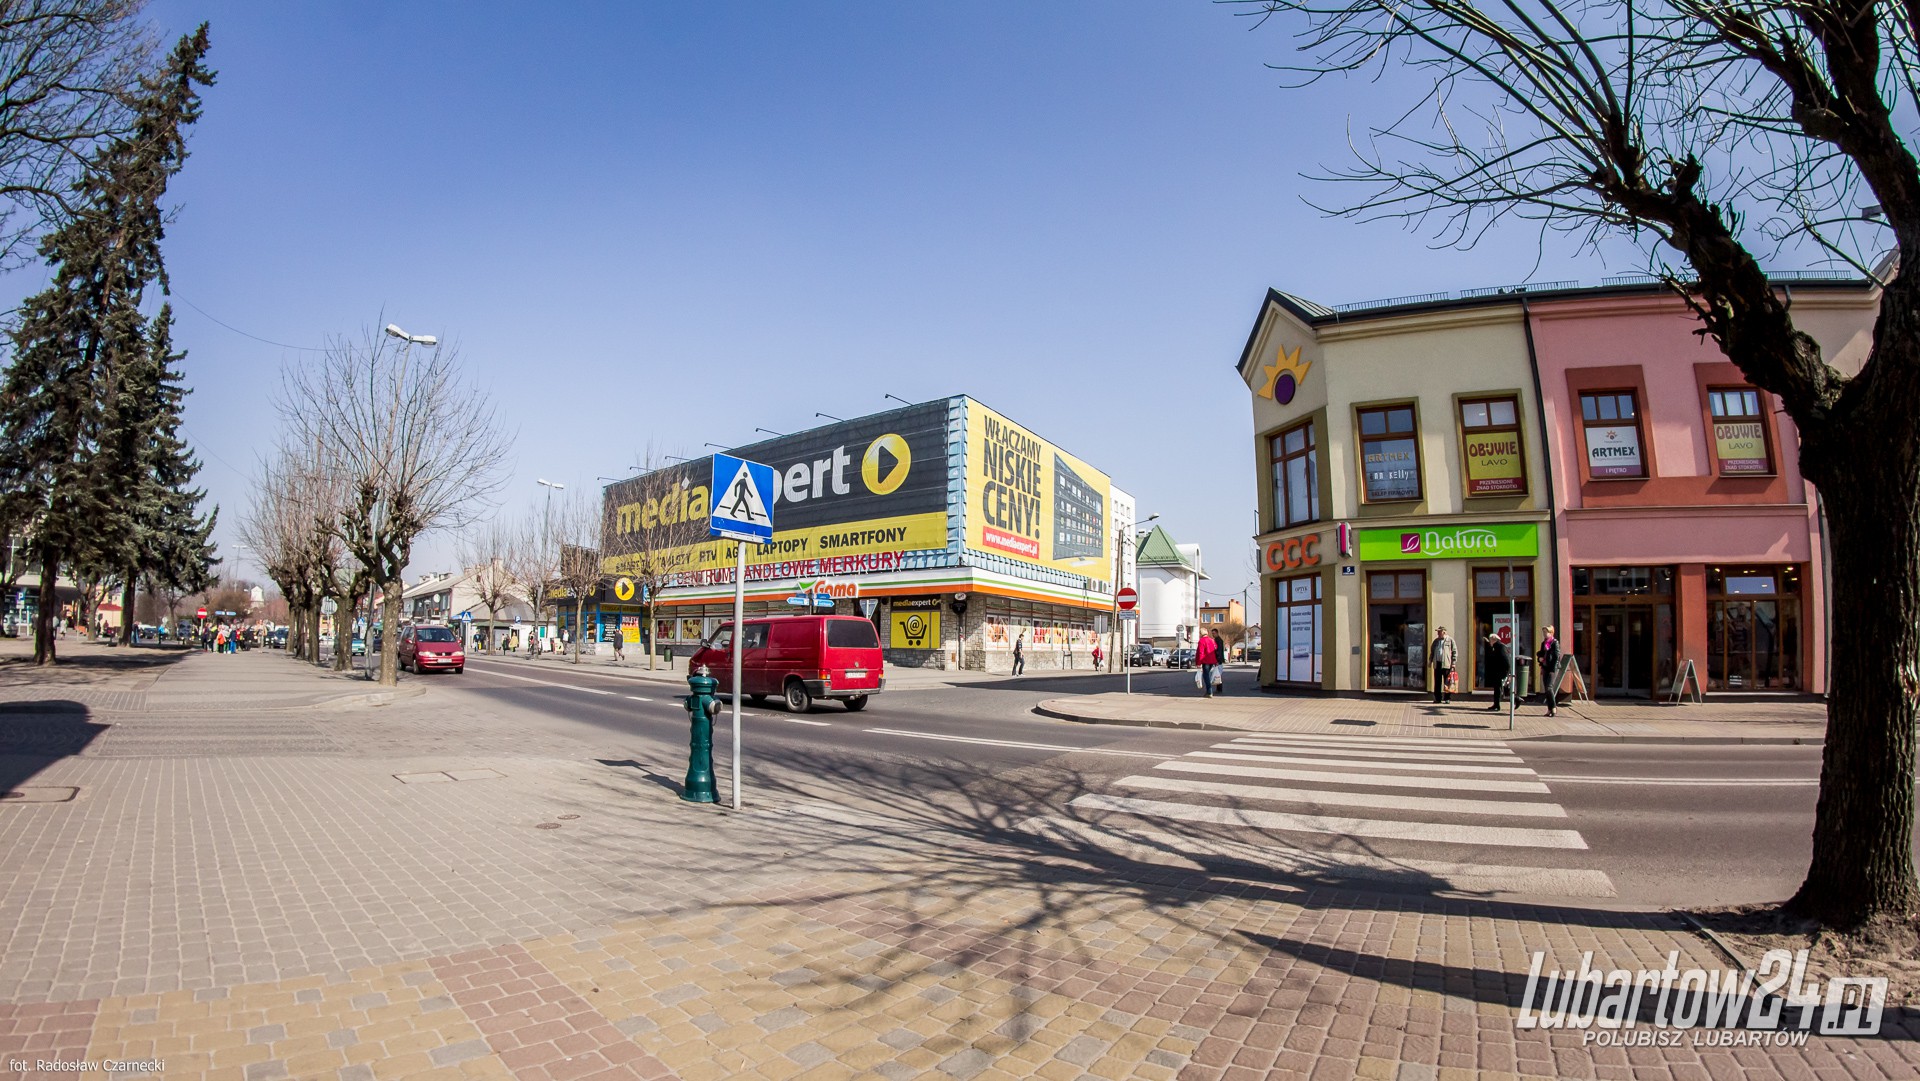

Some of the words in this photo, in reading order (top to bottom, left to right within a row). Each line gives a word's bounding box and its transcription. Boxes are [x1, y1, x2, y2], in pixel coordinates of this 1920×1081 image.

[984, 415, 1041, 462] WŁĄCZAMY
[1716, 424, 1762, 440] OBUWIE
[1469, 441, 1518, 457] OBUWIE
[1592, 446, 1636, 458] ARTMEX
[1728, 442, 1754, 450] LAVO
[984, 438, 1041, 498] NISKIE
[1481, 458, 1508, 466] LAVO
[983, 481, 1041, 539] CENY!
[726, 546, 745, 559] AG
[757, 538, 808, 556] LAPTOPY
[819, 527, 907, 549] SMARTFONY
[985, 531, 1038, 556] www.mediaexpert.pl
[1266, 534, 1320, 571] CCC
[1422, 529, 1497, 556] Natura
[734, 558, 815, 581] ANDLOWE
[819, 549, 905, 575] MERKURY
[814, 580, 857, 597] Gama
[892, 599, 931, 607] mediaexpert
